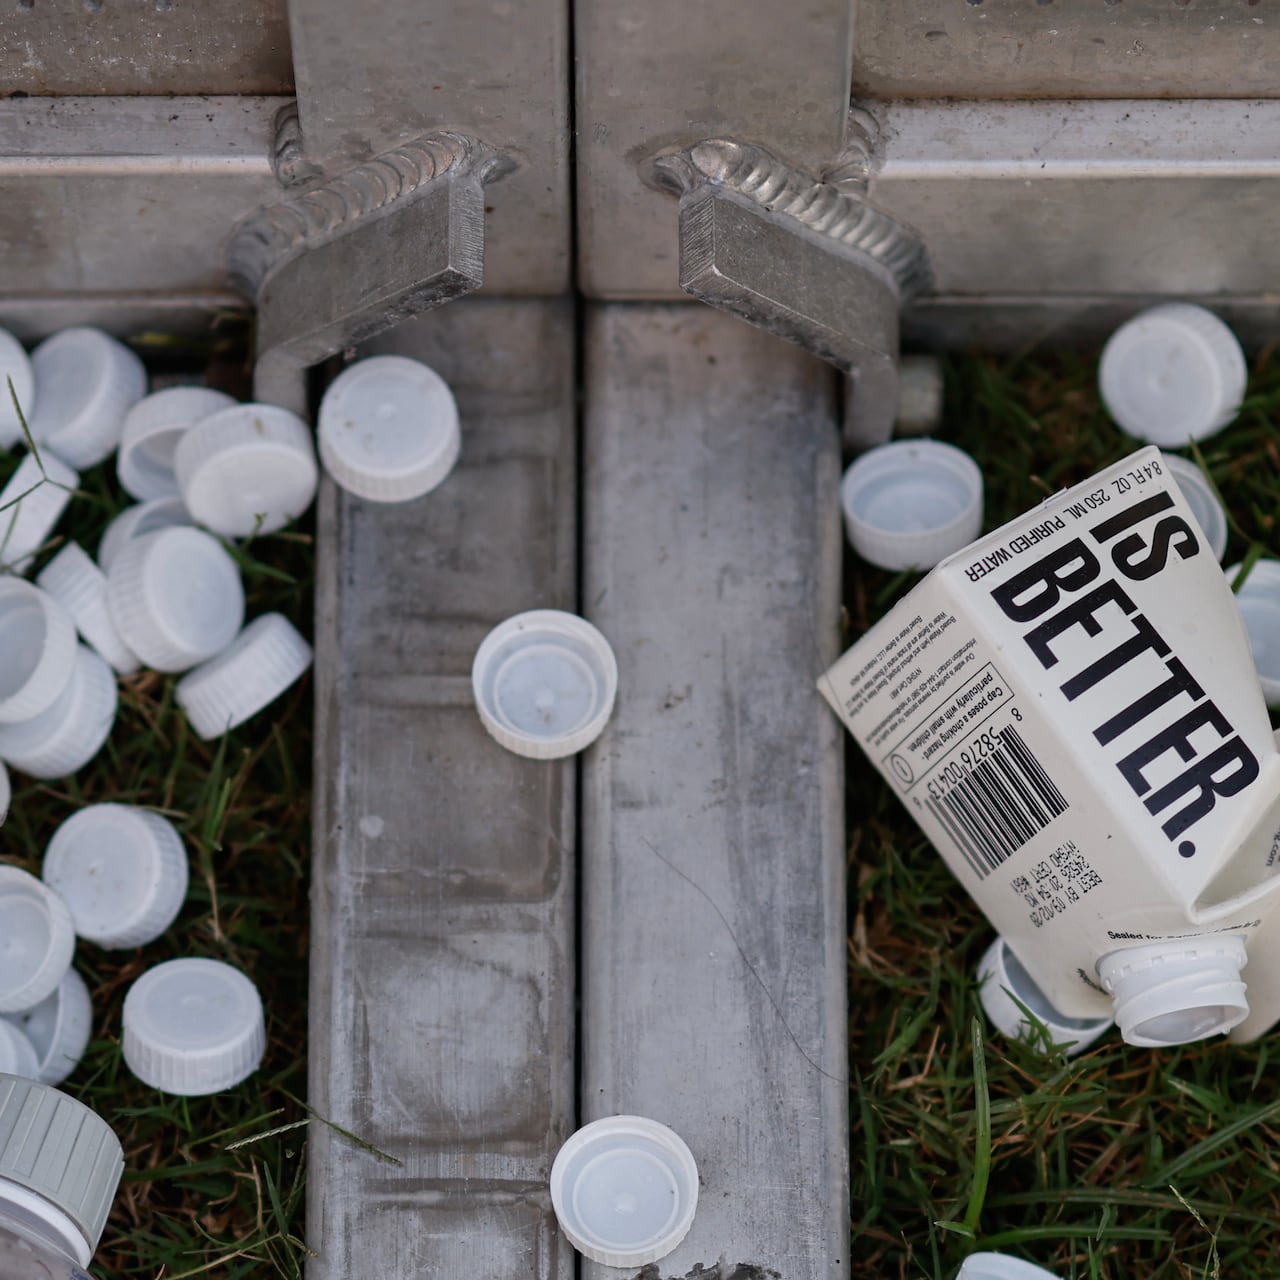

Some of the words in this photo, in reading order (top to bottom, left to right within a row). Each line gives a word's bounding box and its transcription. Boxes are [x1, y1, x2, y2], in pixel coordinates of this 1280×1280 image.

[1128, 469, 1146, 485] FL
[1142, 460, 1163, 478] 8.4
[1111, 477, 1131, 495] OZ
[1088, 487, 1111, 508] 250
[1065, 500, 1089, 518] ML
[1009, 515, 1066, 553] PURIFIED
[1088, 490, 1200, 582] IS
[964, 545, 1013, 582] WATER
[963, 651, 975, 663] Our
[947, 670, 994, 717] particularly
[981, 685, 1003, 704] Cap
[989, 536, 1260, 859] BETTER.
[934, 709, 953, 728] with
[962, 695, 988, 723] poses
[1009, 706, 1023, 722] 8
[922, 720, 940, 740] small
[957, 715, 968, 727] a
[909, 733, 927, 752] children.
[937, 718, 964, 747] choking
[922, 739, 942, 759] hazard
[959, 725, 1005, 770] 58276
[926, 760, 967, 802] 00413
[1075, 868, 1103, 894] BEST
[1063, 885, 1080, 904] BY
[1107, 930, 1143, 940] Sealed
